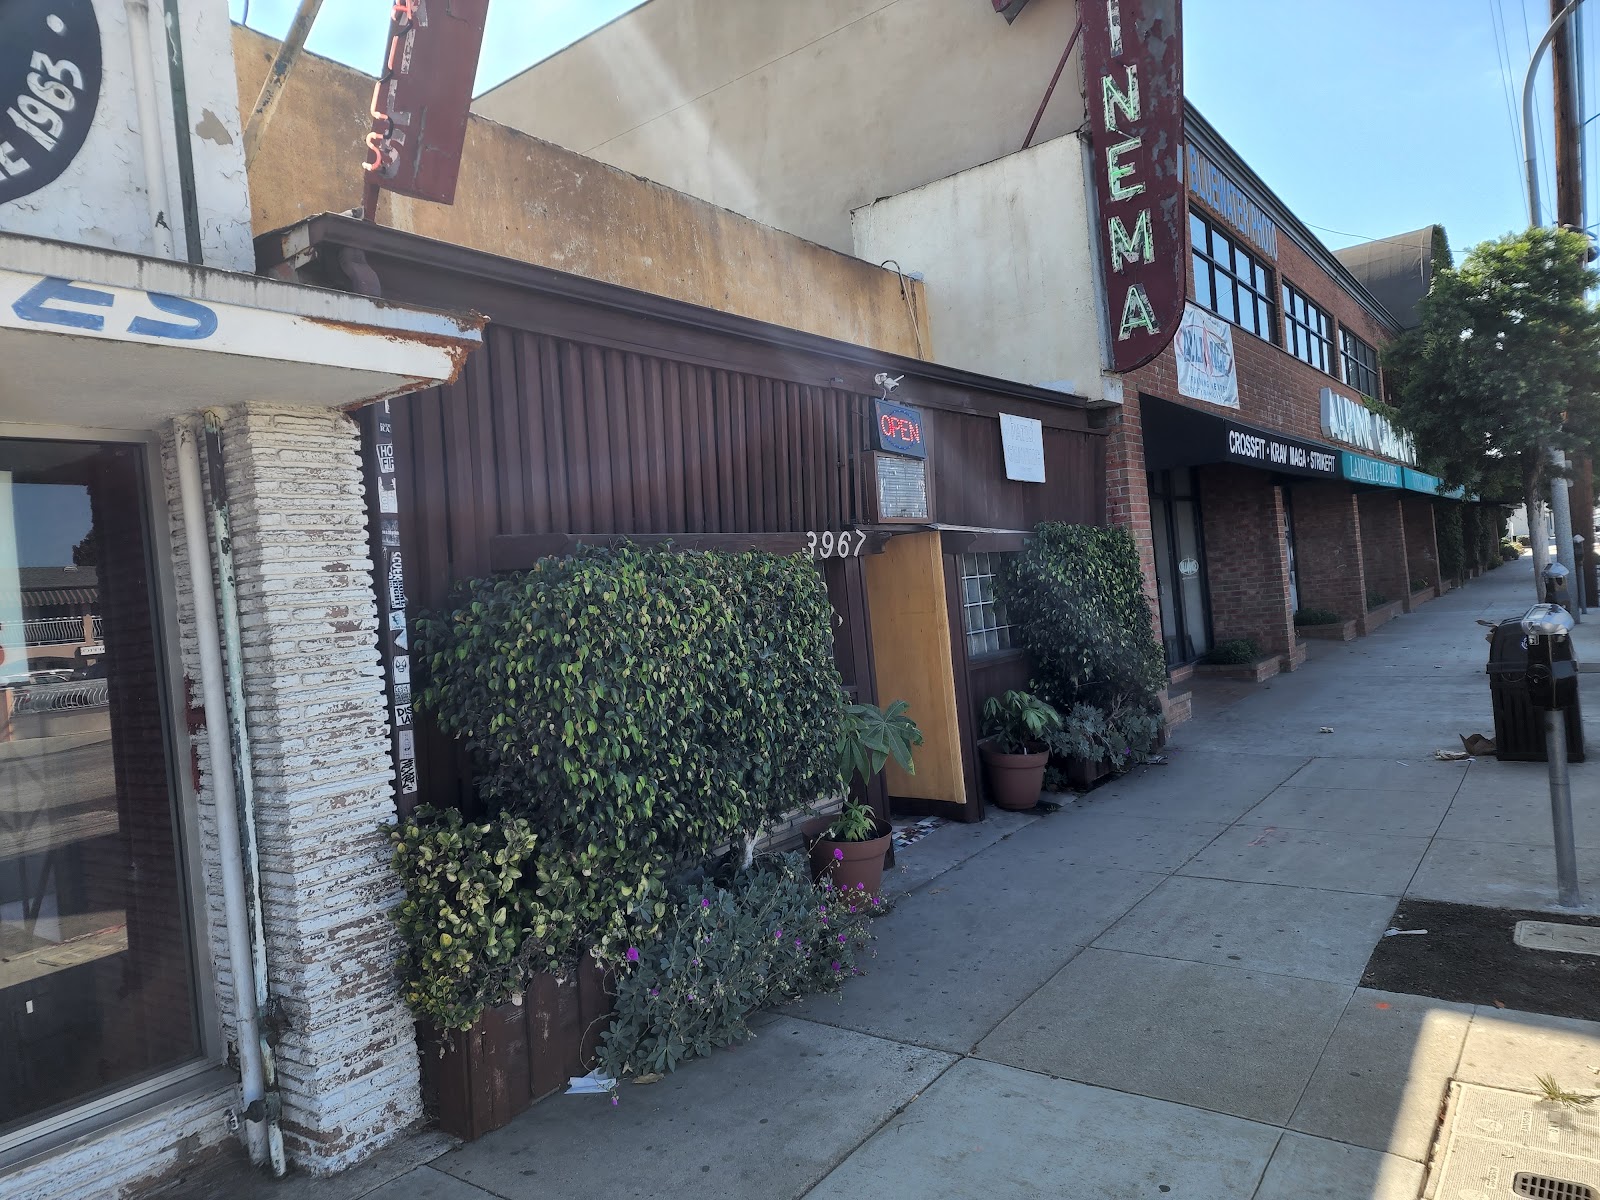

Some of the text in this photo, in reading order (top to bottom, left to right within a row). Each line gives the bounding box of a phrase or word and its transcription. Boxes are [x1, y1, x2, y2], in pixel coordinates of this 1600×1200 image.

[6, 50, 83, 152] 1963
[1186, 143, 1277, 262] BLUEWATER PHOTO
[881, 415, 920, 444] OPEN
[1229, 430, 1335, 473] CROSSFIT KRAV MAGA STRIKEFIT
[1349, 455, 1379, 482] LAMINATE
[1380, 462, 1398, 484] FLOORS
[802, 529, 867, 558] 3967
